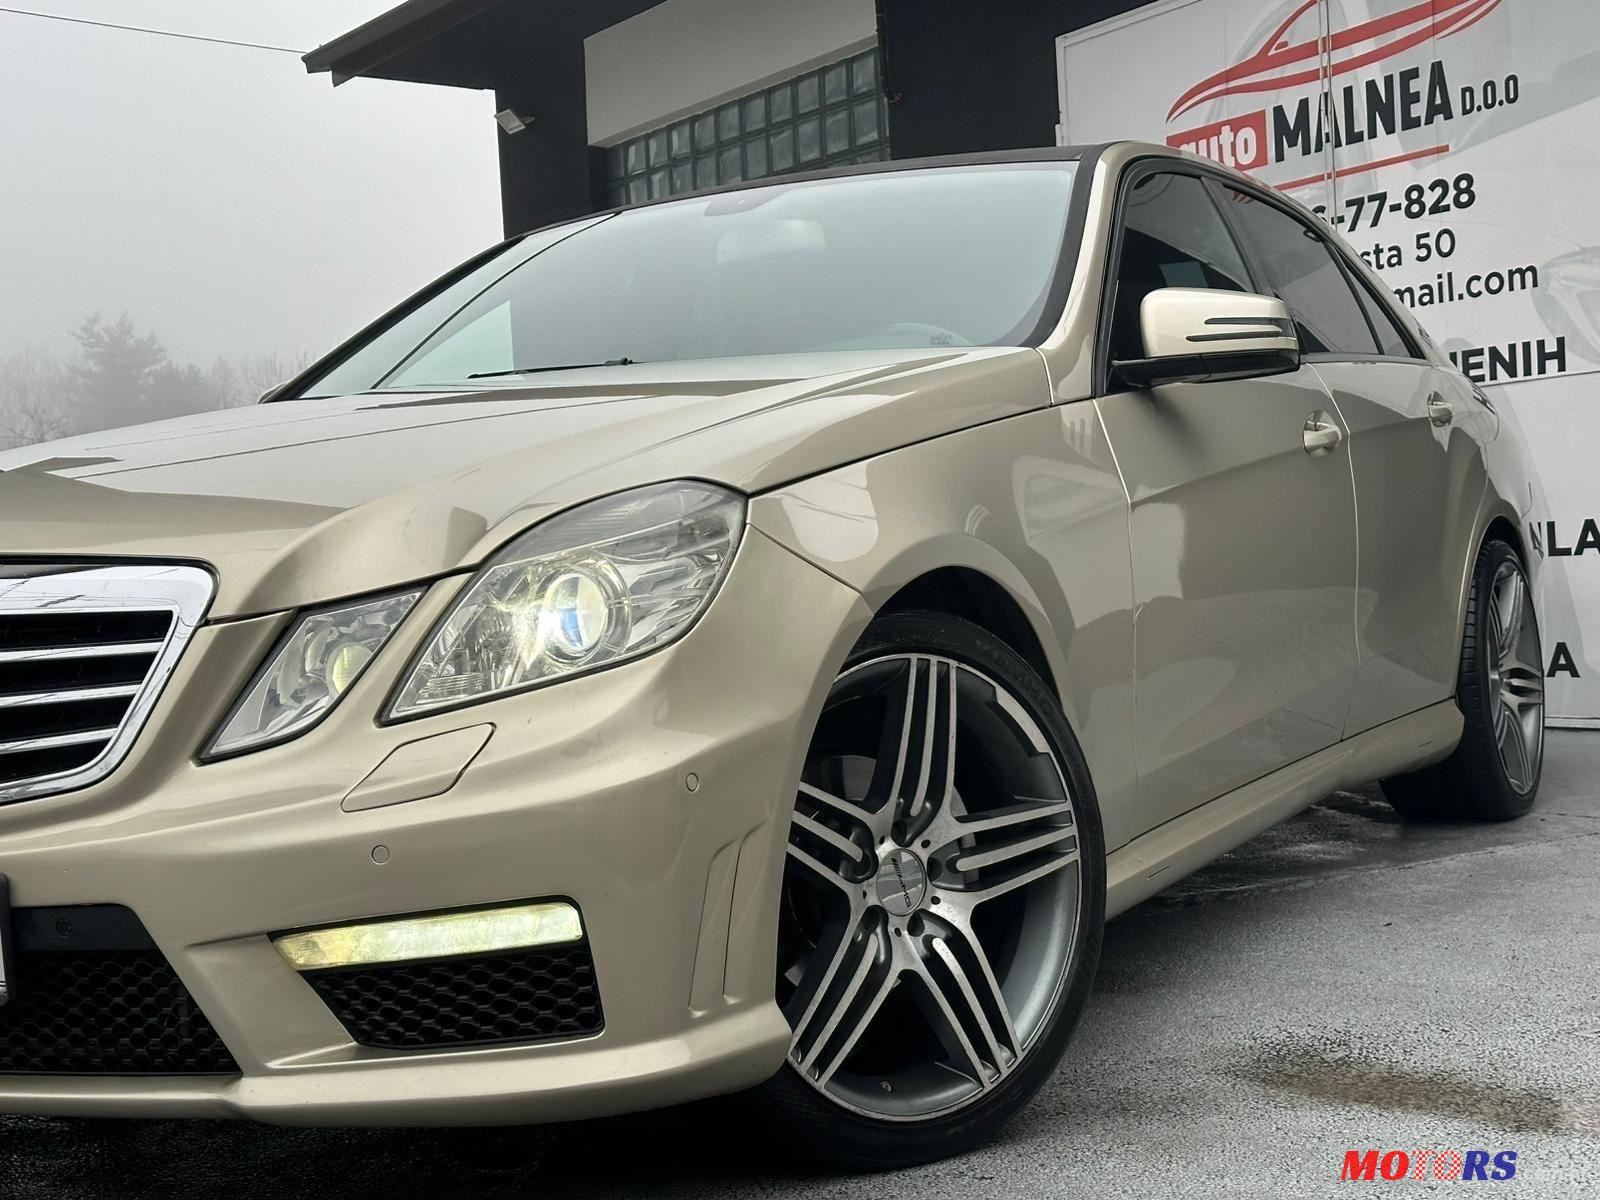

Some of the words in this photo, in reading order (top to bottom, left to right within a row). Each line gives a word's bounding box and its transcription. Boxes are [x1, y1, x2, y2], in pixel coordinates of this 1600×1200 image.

[1273, 60, 1454, 163] MALNEA
[1415, 228, 1456, 263] 50
[1546, 641, 1581, 678] A
